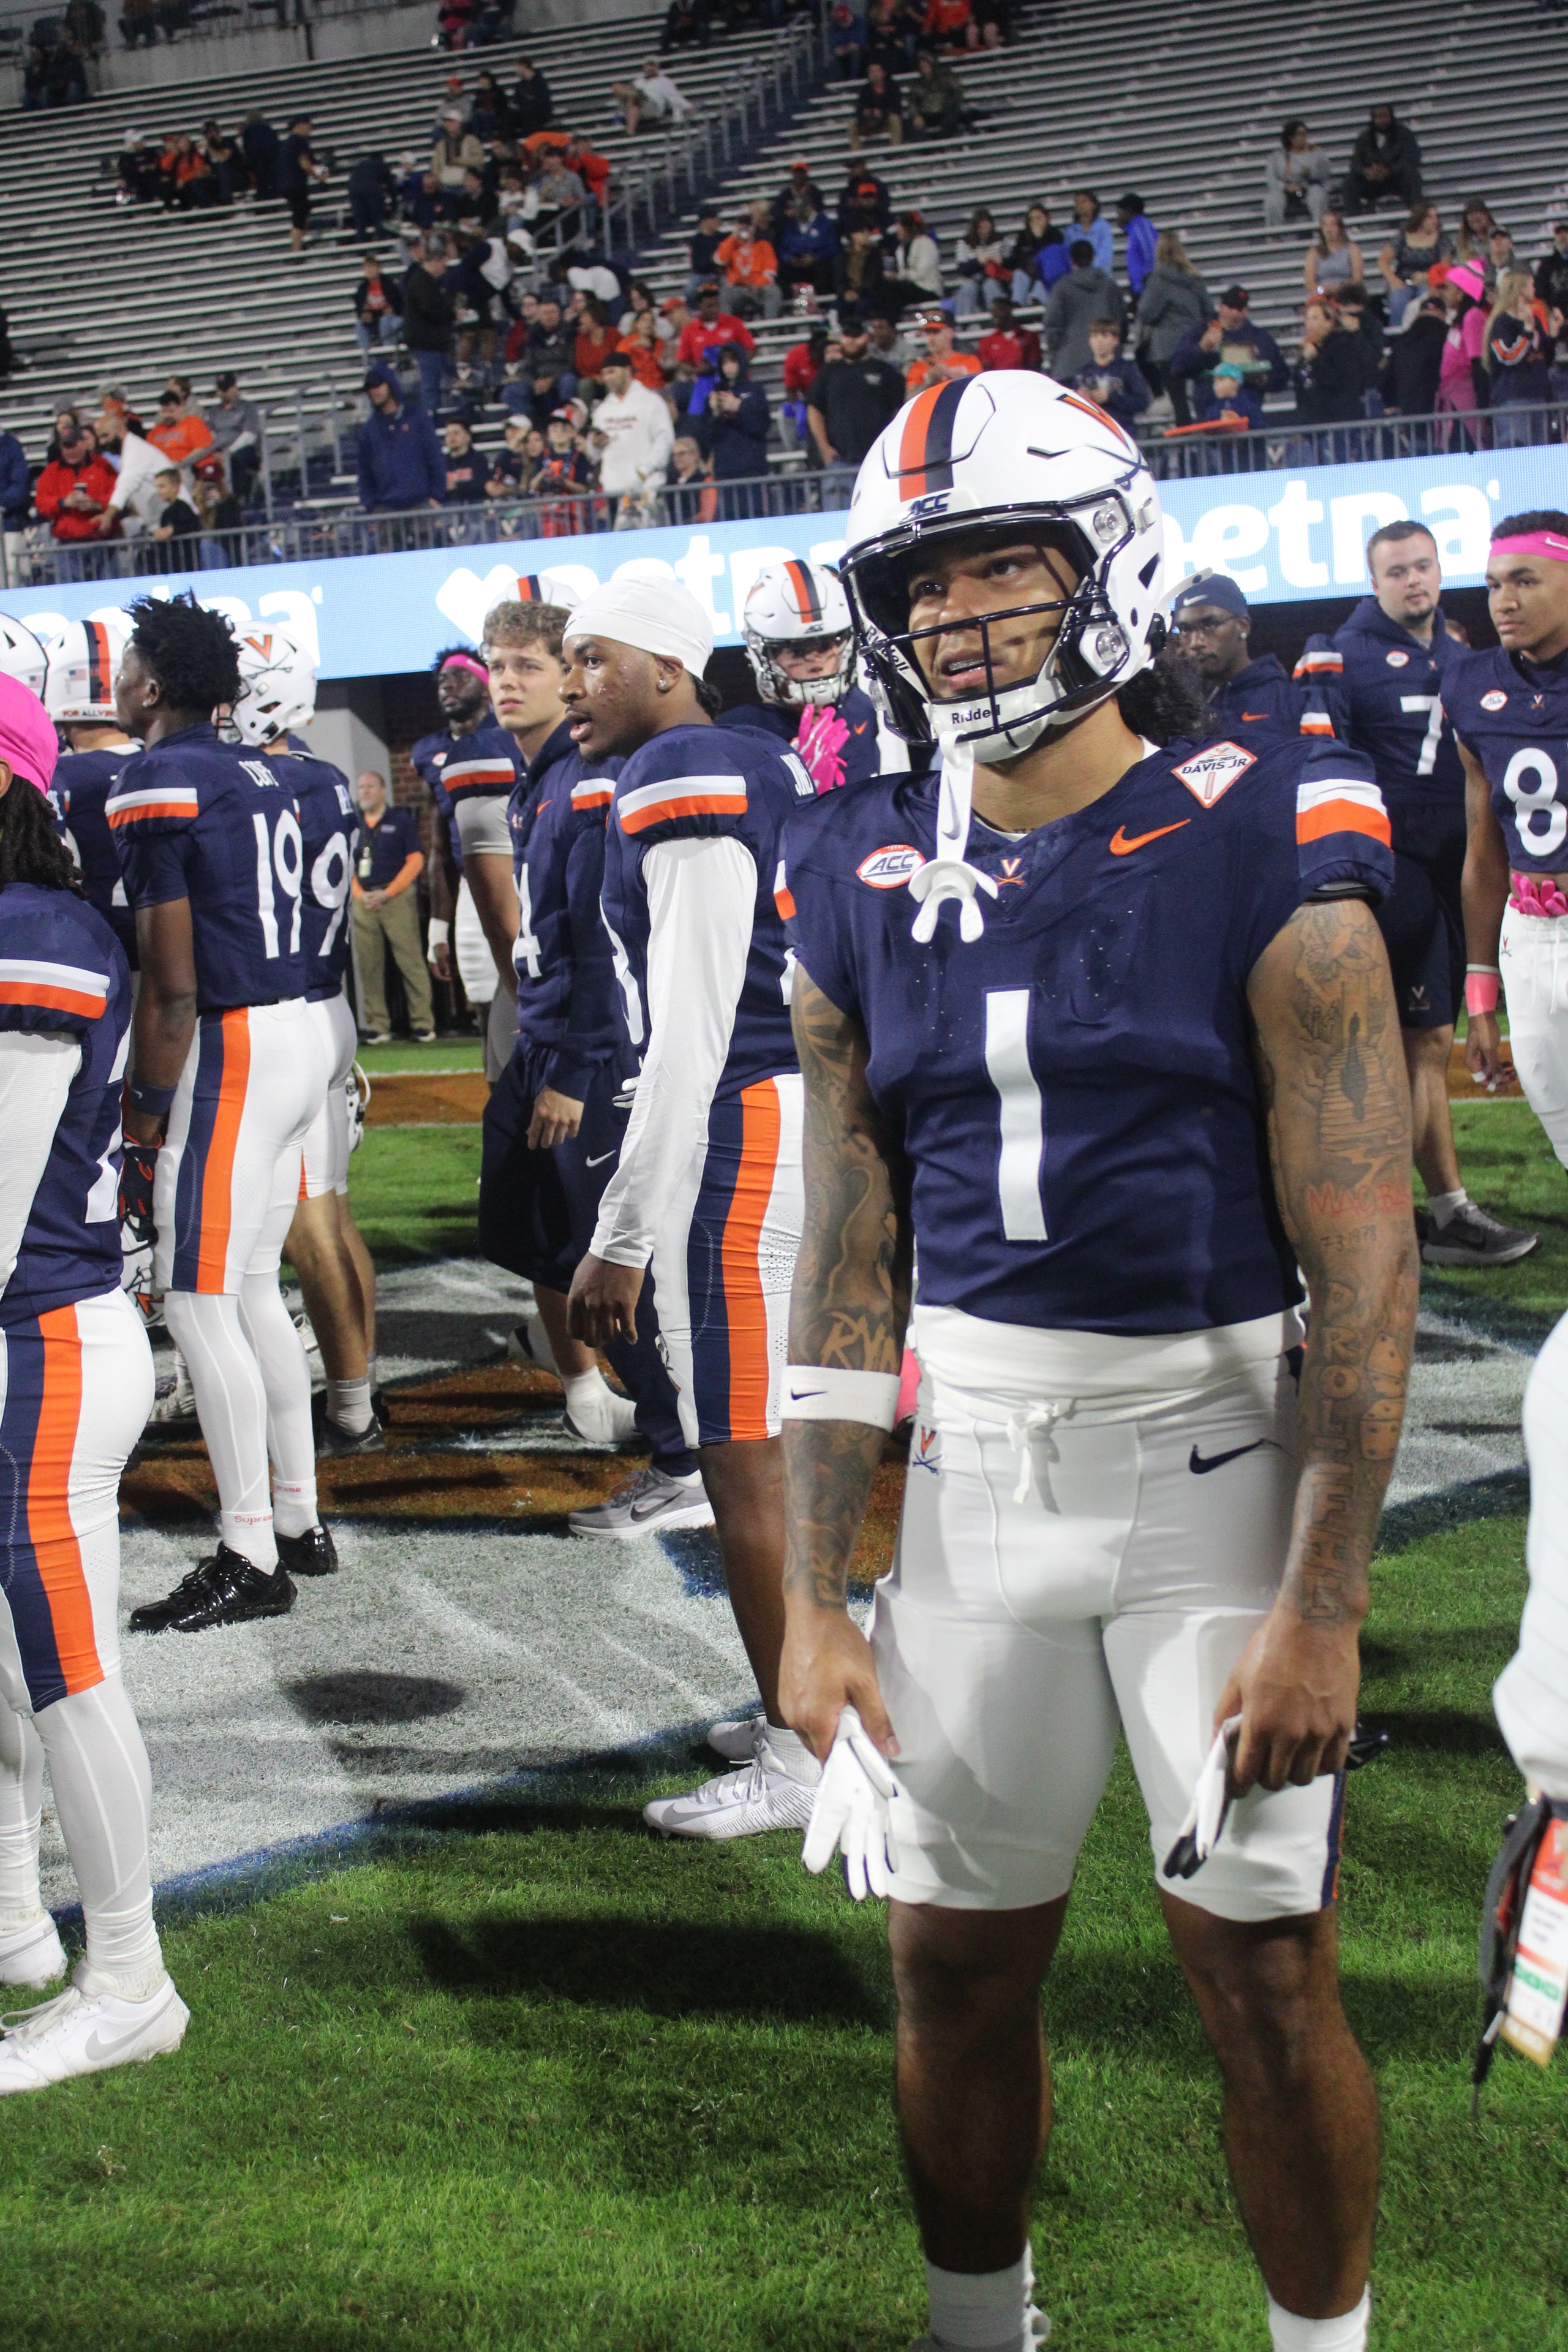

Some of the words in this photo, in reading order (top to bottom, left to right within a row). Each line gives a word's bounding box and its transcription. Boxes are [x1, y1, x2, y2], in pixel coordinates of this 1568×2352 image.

[902, 492, 951, 522] ACC
[952, 704, 1001, 725] Riddel
[1400, 693, 1442, 775] 7
[1182, 761, 1226, 774] DAVIS
[1227, 758, 1248, 769] JR
[1204, 771, 1216, 799] 1
[1504, 747, 1567, 856] 8
[865, 852, 919, 874] ACC
[252, 809, 303, 960] 19
[985, 989, 1049, 1241] 1
[276, 1485, 301, 1494] preme
